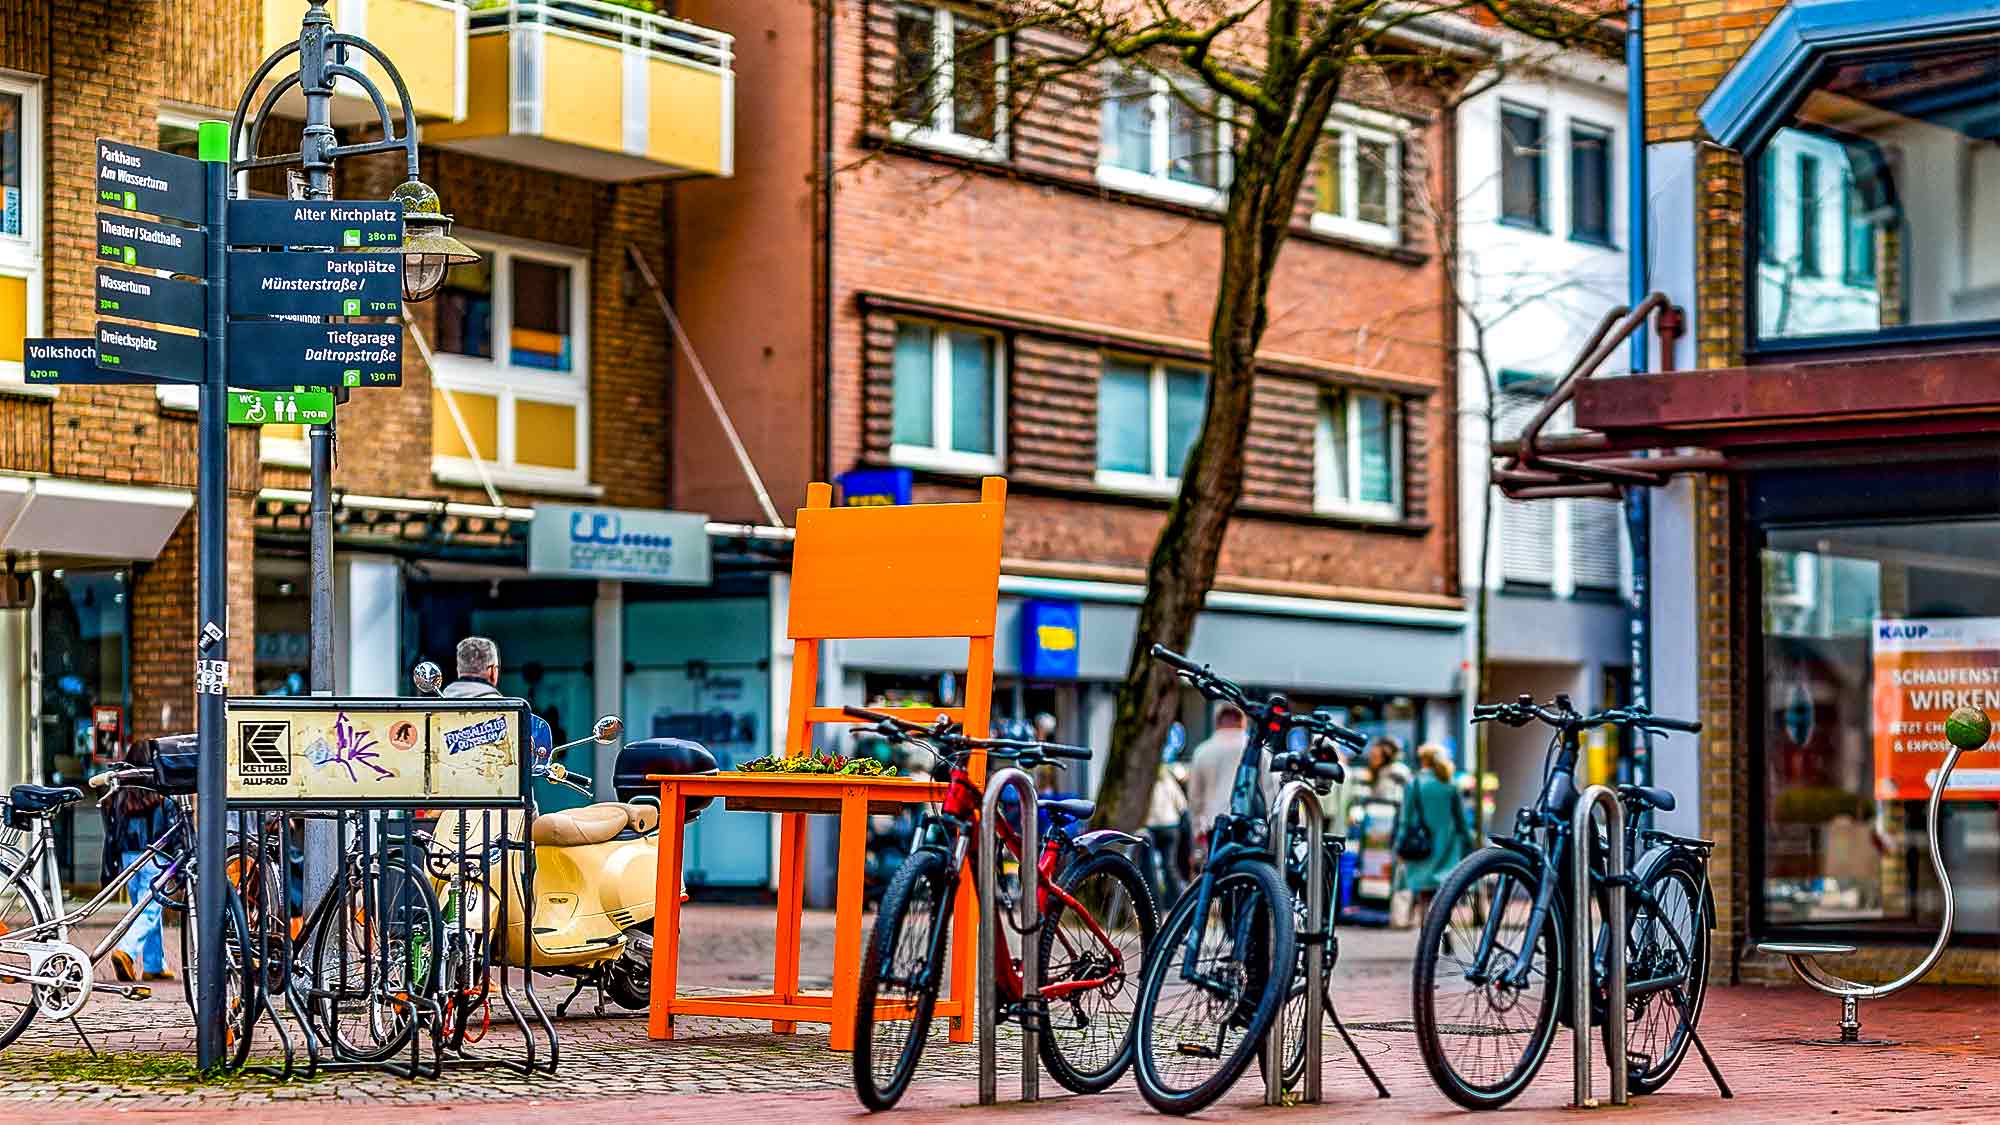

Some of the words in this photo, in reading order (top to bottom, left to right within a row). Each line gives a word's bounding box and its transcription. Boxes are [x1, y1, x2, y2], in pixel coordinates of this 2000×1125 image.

[101, 145, 141, 168] Parkhaus
[101, 165, 115, 180] Am
[117, 169, 168, 192] Wasserturm
[294, 208, 327, 221] Alter
[330, 207, 397, 224] Kirchplatz
[101, 220, 134, 239] Theater
[139, 227, 182, 248] Stadthalle
[368, 232, 386, 242] 380
[387, 233, 397, 241] m
[327, 260, 396, 275] Parkplätze
[100, 274, 151, 296] Wasserturm
[261, 277, 356, 293] Münsterstraße
[370, 302, 386, 311] 170
[101, 329, 158, 351] Dreiecksplatz
[327, 331, 396, 346] Tiefgarage
[30, 346, 96, 359] Volkshoch
[305, 348, 397, 364] Daltropstraße
[30, 369, 47, 379] 470
[49, 370, 58, 378] m
[370, 373, 386, 381] 130
[239, 395, 254, 404] WC
[302, 410, 317, 419] 170
[317, 410, 328, 418] m
[1879, 623, 1929, 639] KAUP
[1910, 689, 2000, 711] WIRKEN
[243, 777, 288, 786] ALU-RAD
